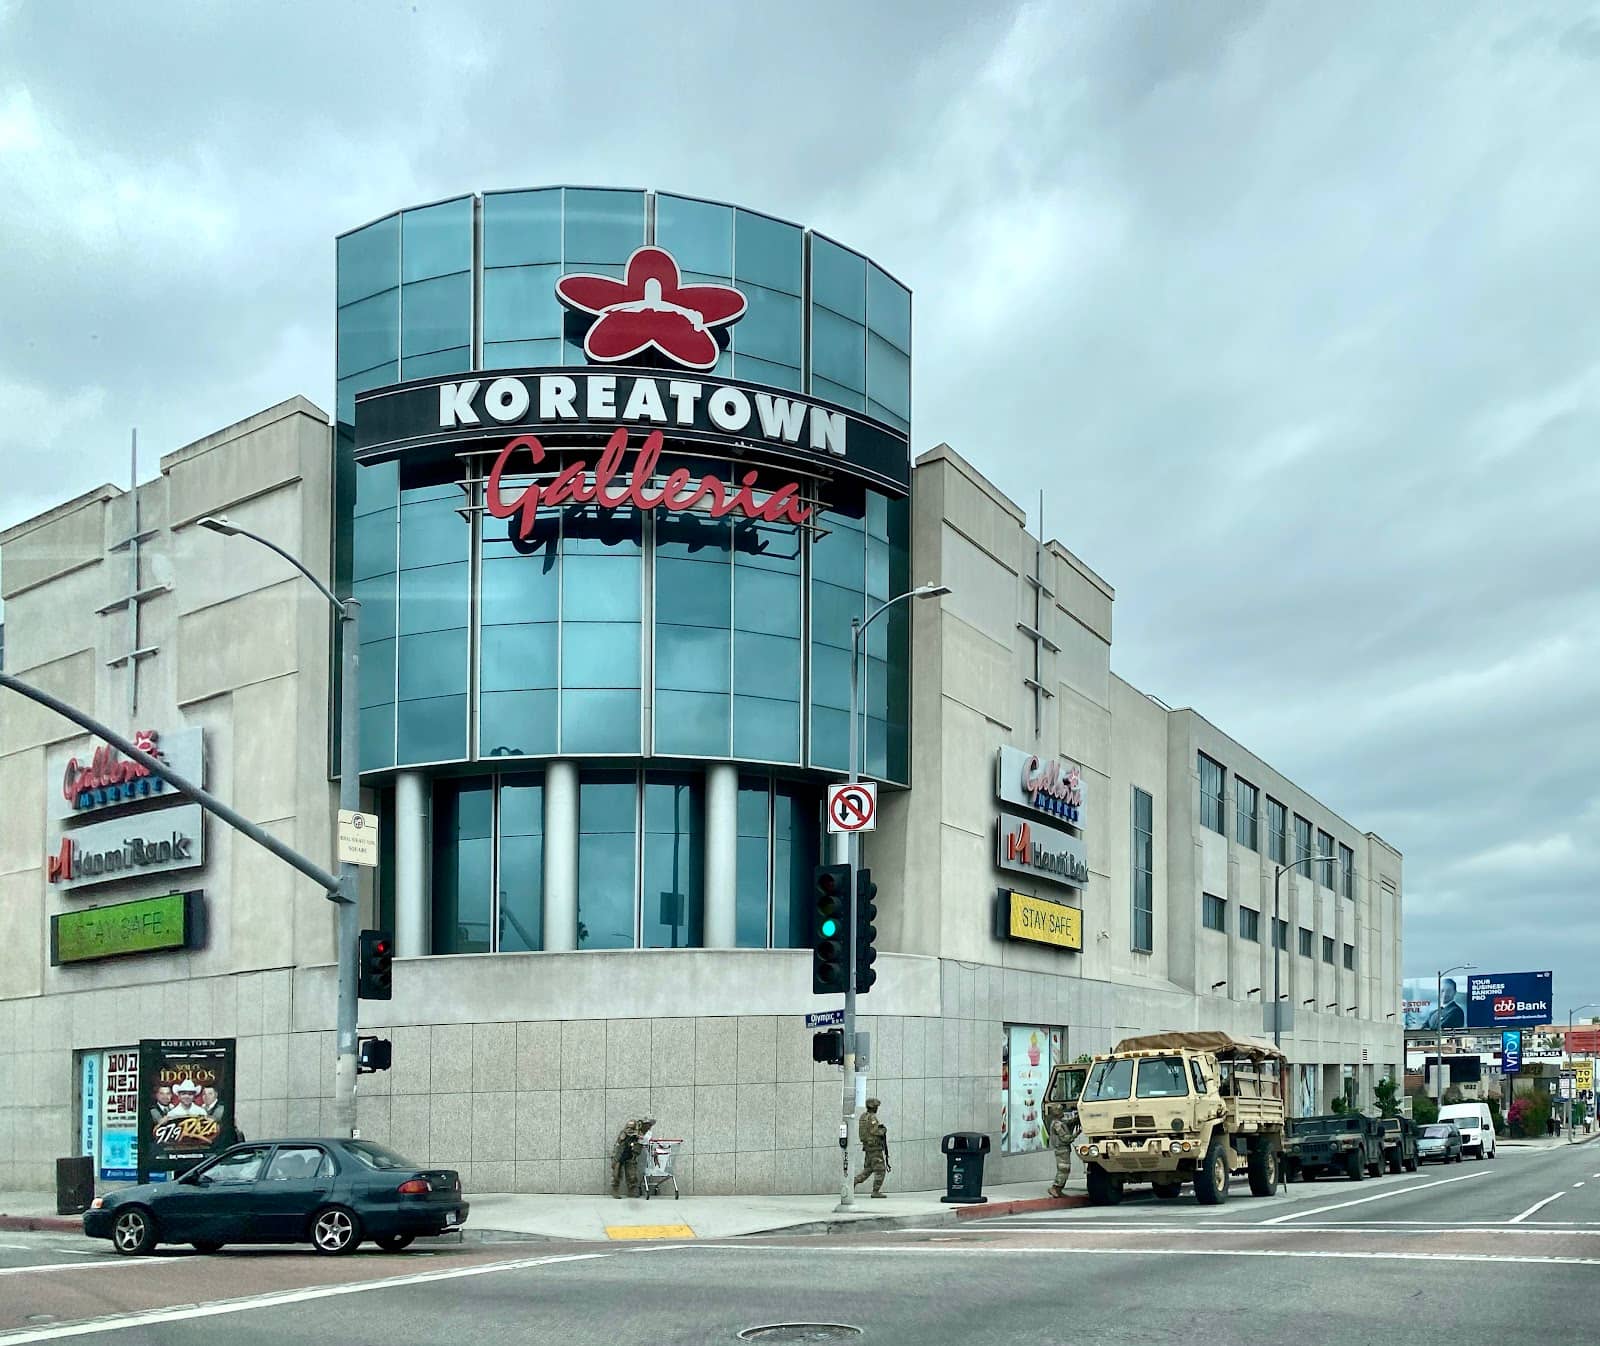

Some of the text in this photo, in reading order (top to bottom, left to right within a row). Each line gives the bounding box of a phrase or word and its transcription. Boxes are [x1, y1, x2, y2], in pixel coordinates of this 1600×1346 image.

[439, 376, 847, 457] KOREATOWN
[487, 427, 814, 540] Galleria
[1022, 907, 1047, 931] STAY
[811, 1012, 835, 1024] Olympic
[1494, 1000, 1548, 1012] cbb Bank
[161, 1039, 216, 1047] KOREATOWN
[156, 1117, 218, 1144] 97.9 RAZA
